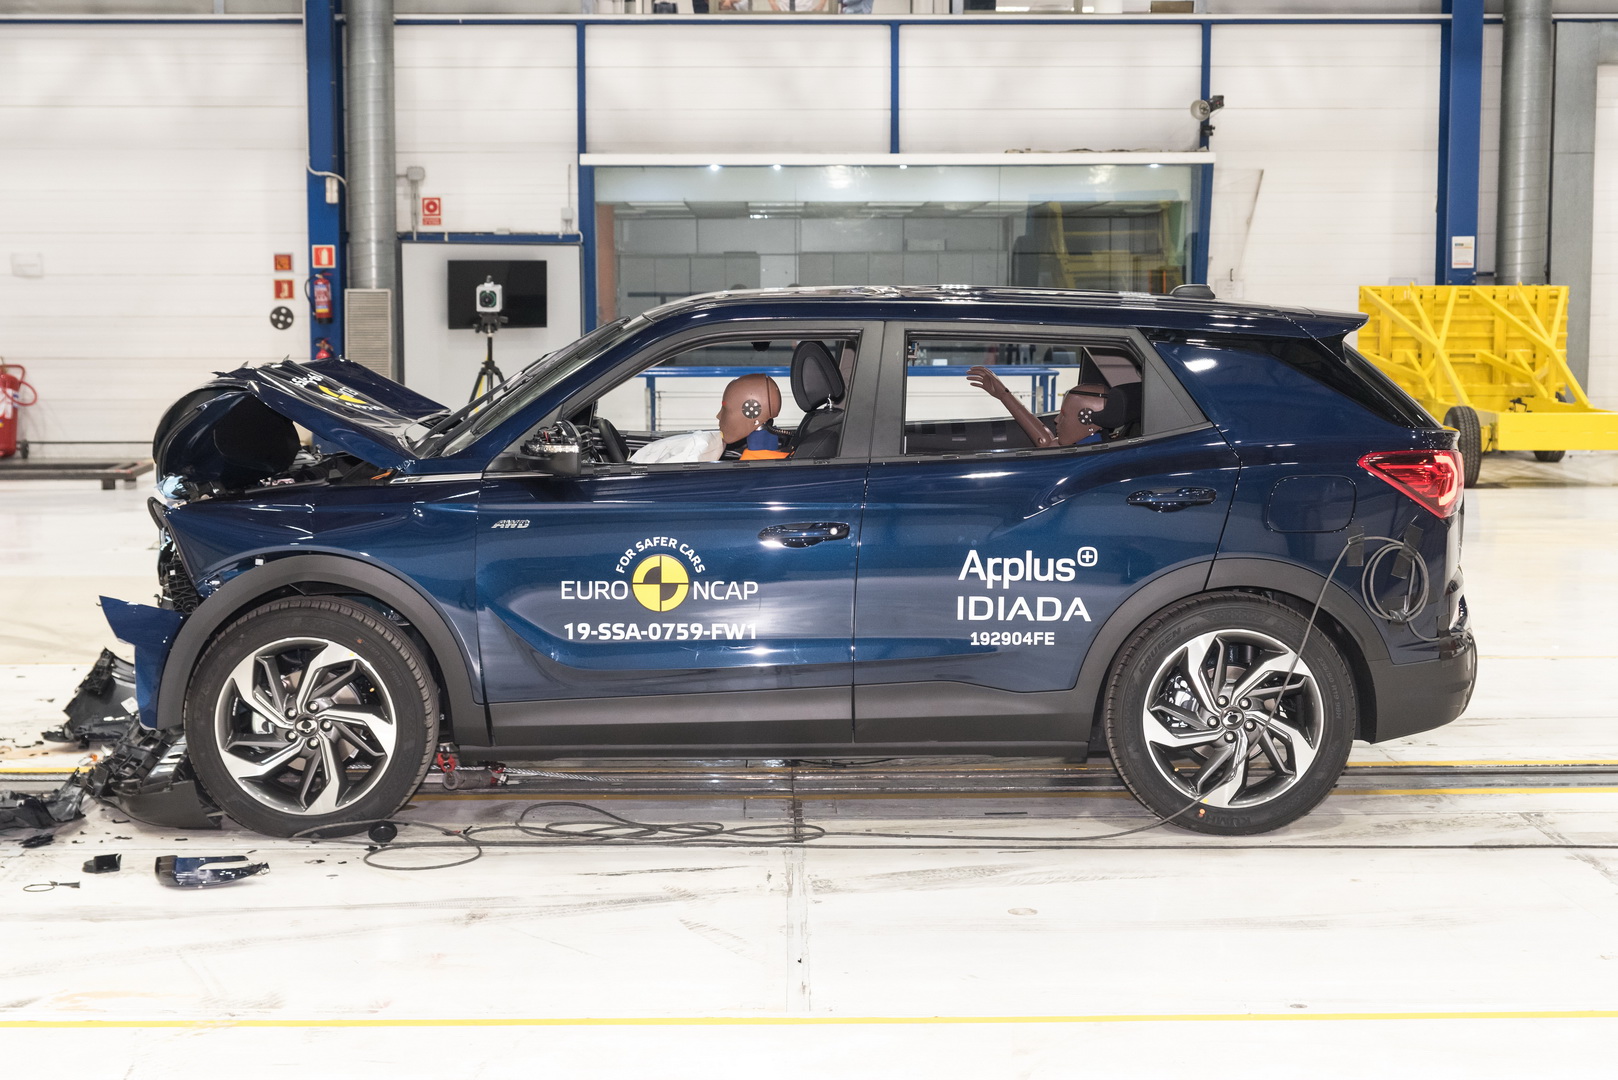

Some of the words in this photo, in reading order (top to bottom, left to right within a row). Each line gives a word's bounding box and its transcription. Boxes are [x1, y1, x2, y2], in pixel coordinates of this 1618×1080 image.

[491, 519, 531, 529] AWD
[615, 548, 637, 574] FOR
[635, 536, 678, 552] SAFER
[679, 543, 706, 574] CARS
[560, 580, 629, 600] EURO
[693, 580, 759, 600] NCAP
[957, 595, 1092, 622] IDIADA
[564, 622, 757, 640] 19-SSA-0759-FW1
[970, 631, 1055, 646] 192904FE
